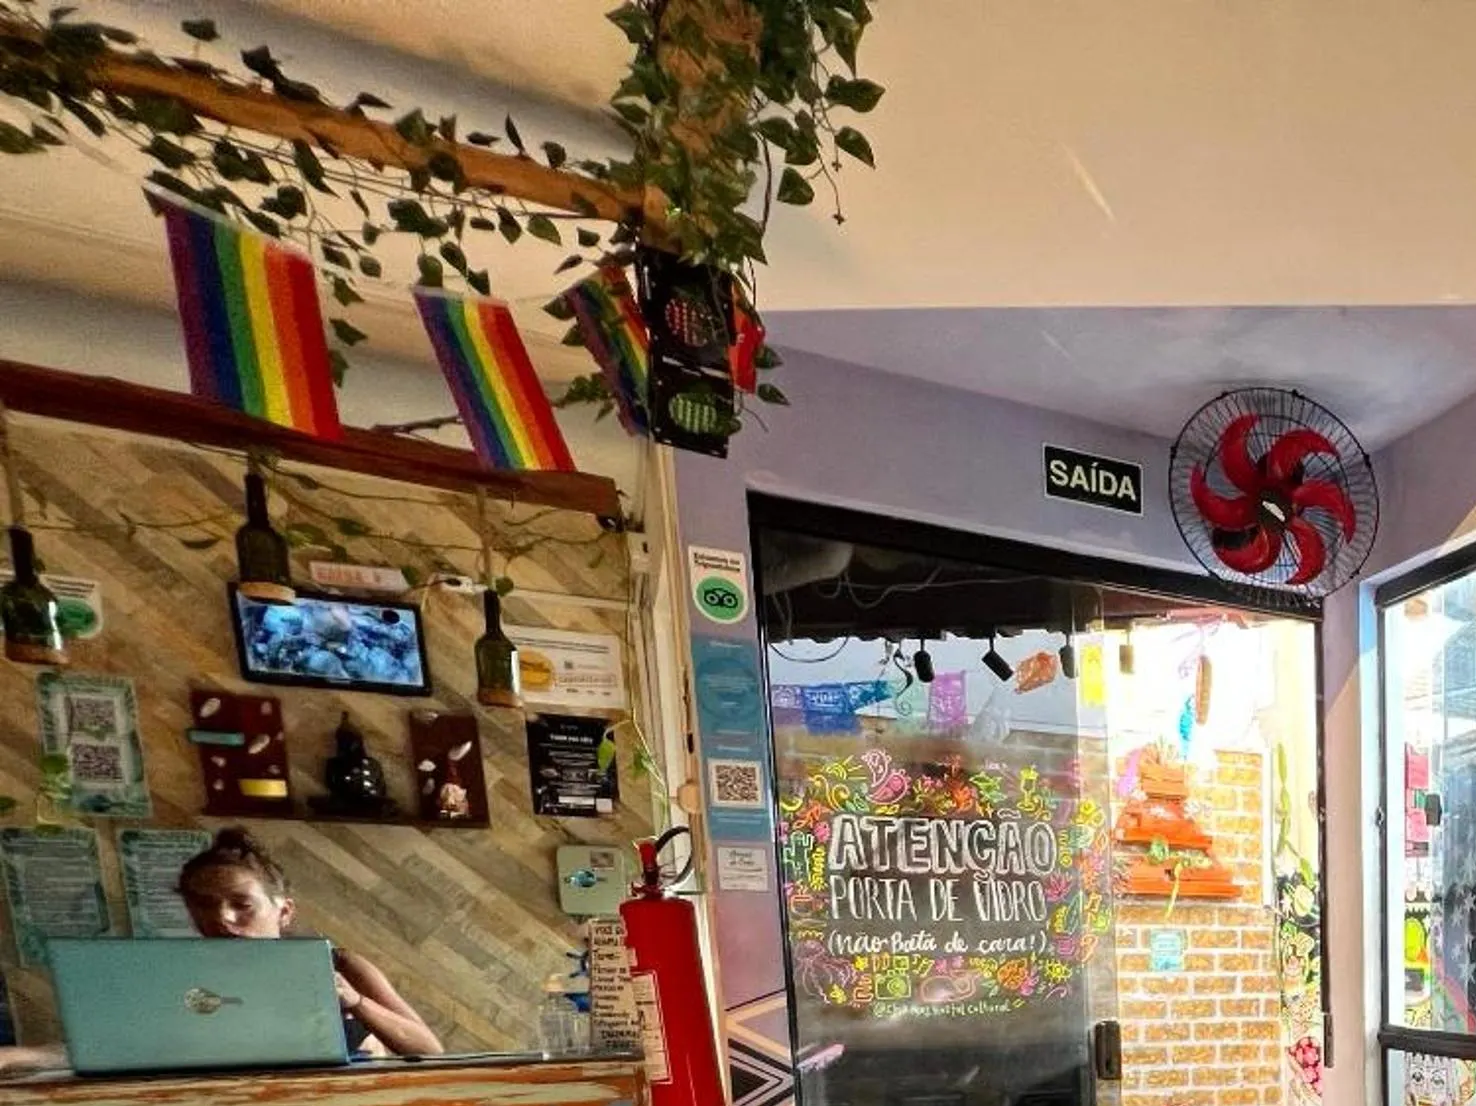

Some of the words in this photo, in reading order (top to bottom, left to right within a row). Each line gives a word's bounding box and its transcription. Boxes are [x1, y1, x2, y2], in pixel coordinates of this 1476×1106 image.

[1049, 460, 1136, 501] SAÍDA
[828, 808, 1058, 878] ATENÇÃO
[829, 875, 918, 922] PORTA
[930, 878, 964, 922] DE
[972, 877, 1049, 922] VIDRO
[944, 931, 969, 954] de
